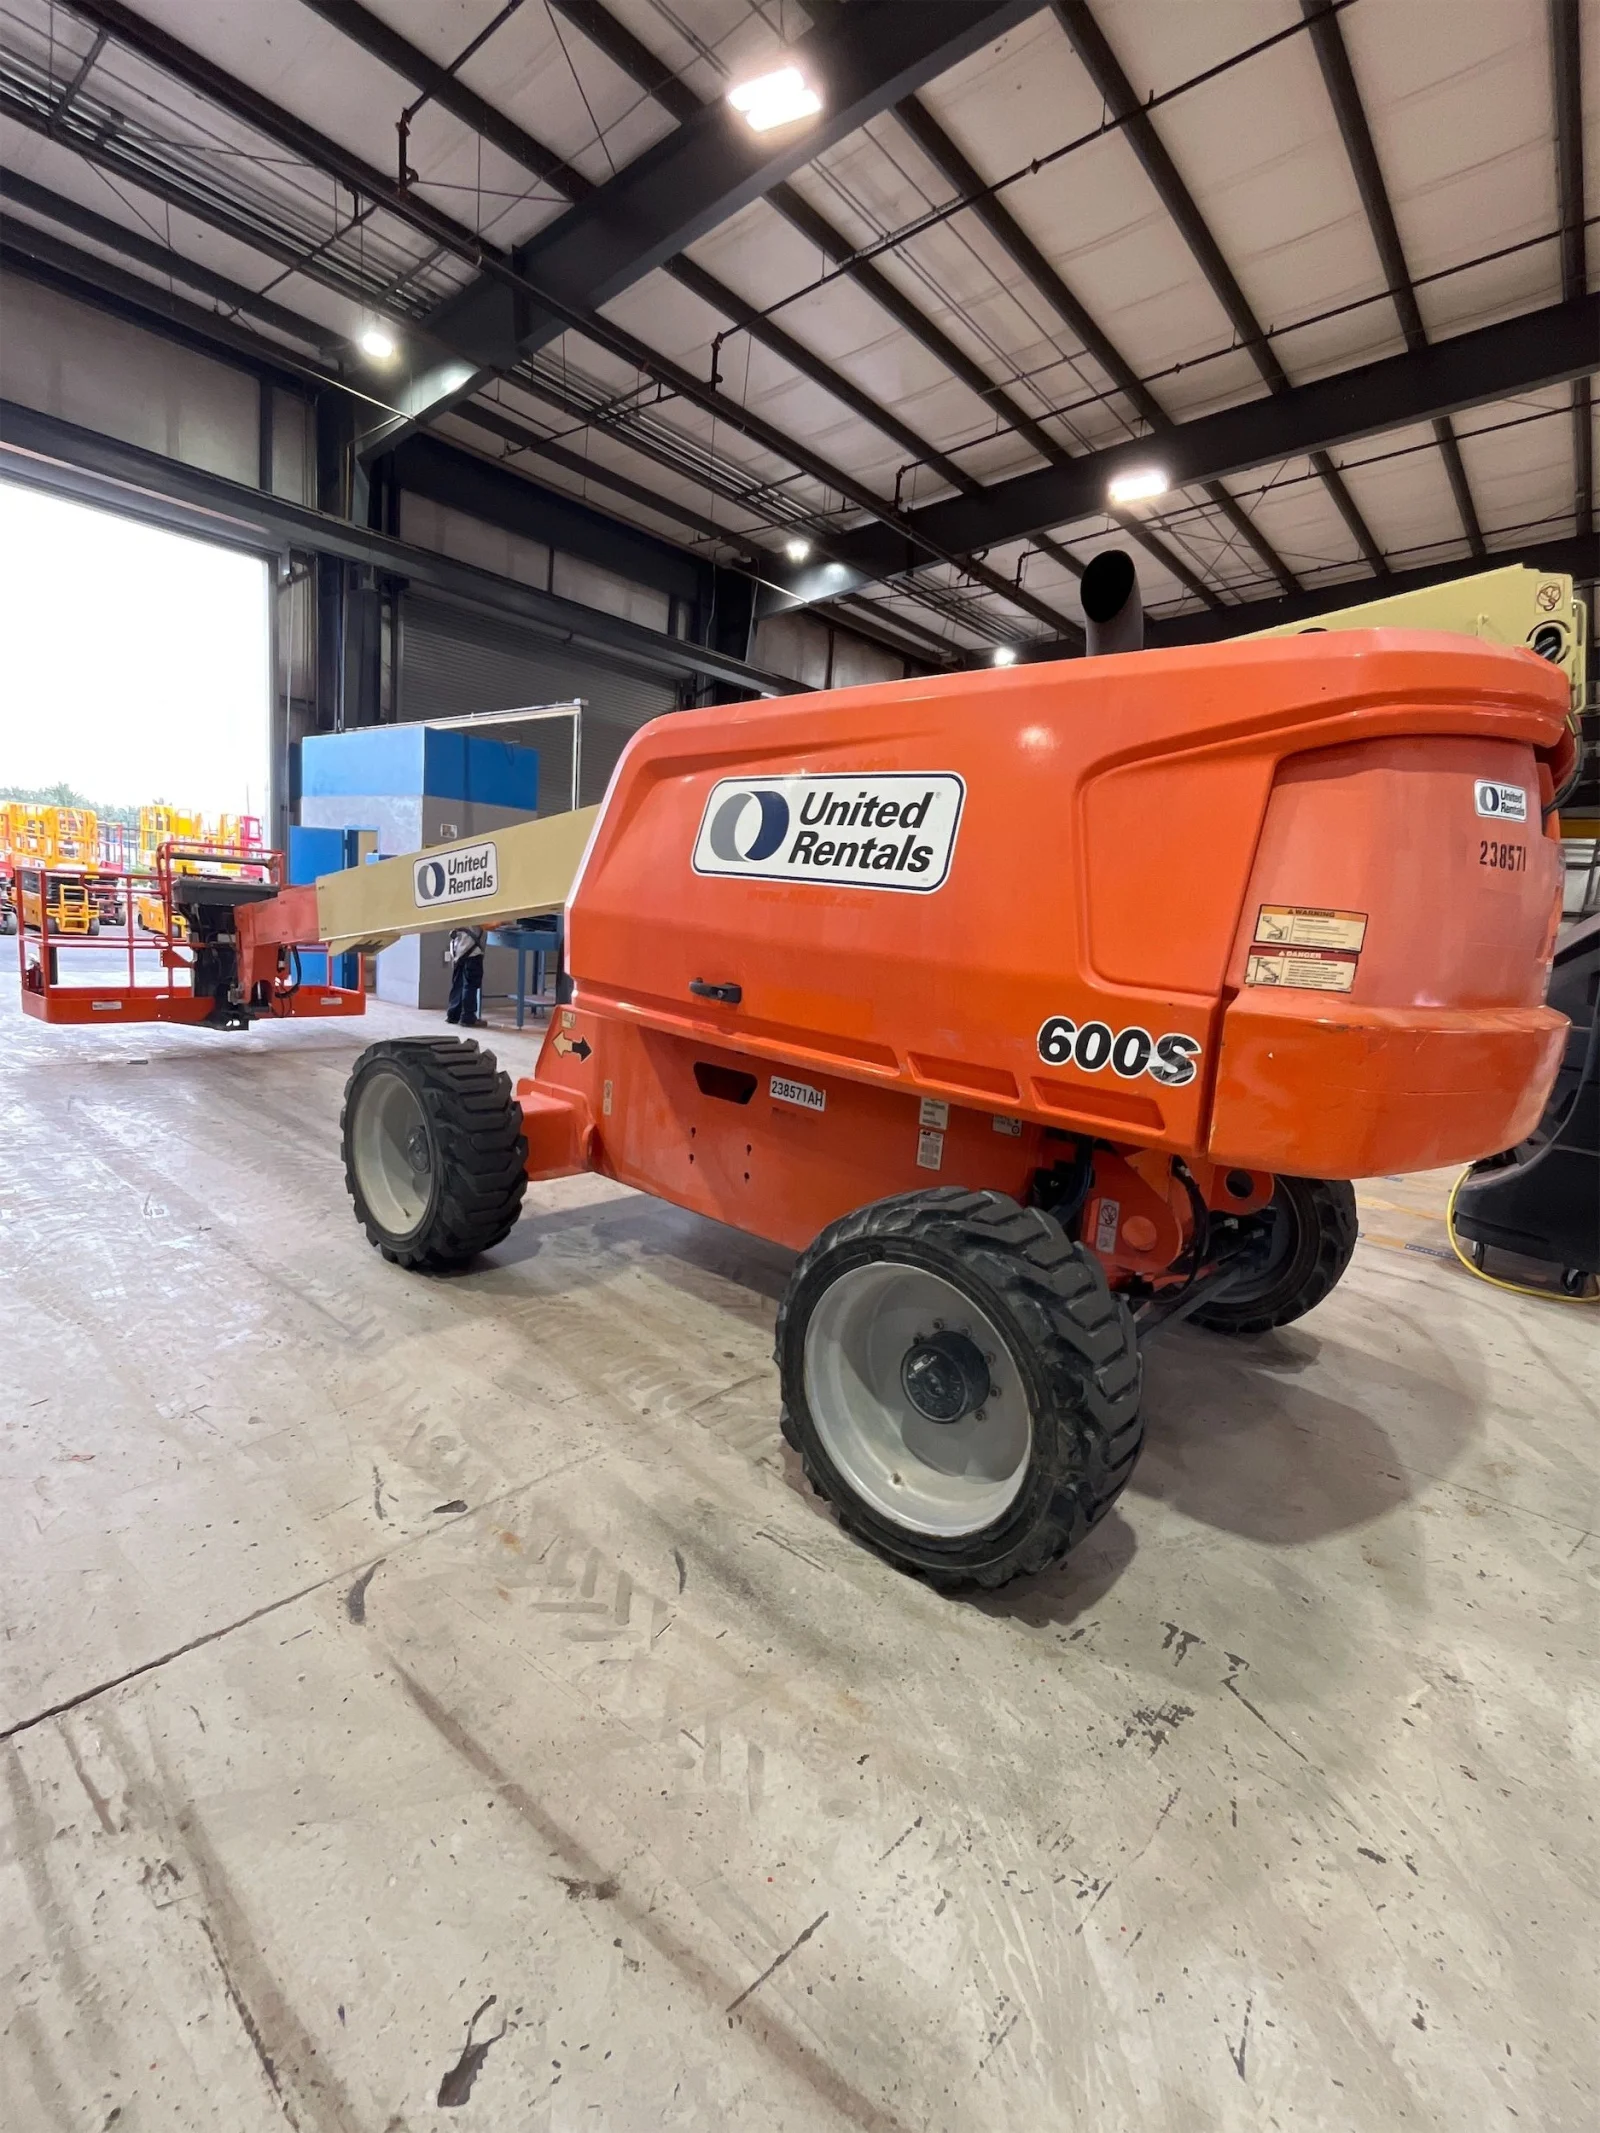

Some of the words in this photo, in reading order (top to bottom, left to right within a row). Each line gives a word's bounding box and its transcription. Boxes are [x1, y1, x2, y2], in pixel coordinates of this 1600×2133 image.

[1501, 789, 1523, 803] United
[800, 791, 934, 829] United
[1501, 802, 1524, 816] Rentals
[448, 850, 489, 875] United
[788, 831, 933, 873] Rentals
[1480, 841, 1526, 872] 238571
[448, 871, 493, 895] Rentals
[1295, 909, 1335, 918] WARNING
[1286, 950, 1322, 959] DANGER
[1038, 1016, 1201, 1086] 600S
[772, 1080, 824, 1107] 238571AH
